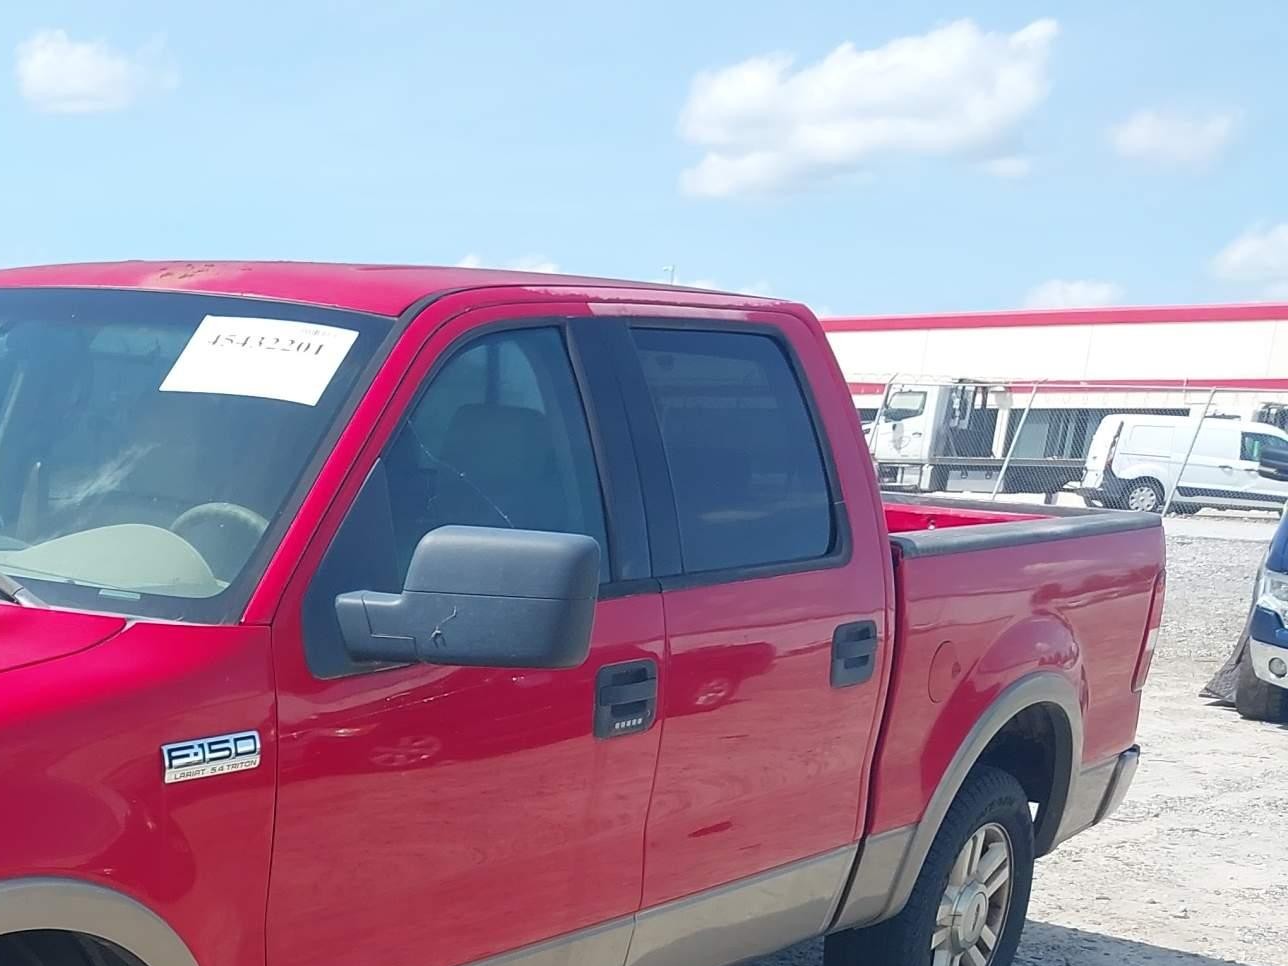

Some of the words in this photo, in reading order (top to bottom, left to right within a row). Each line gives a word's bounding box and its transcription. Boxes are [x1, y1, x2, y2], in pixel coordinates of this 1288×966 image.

[207, 334, 324, 355] 45432201
[167, 734, 258, 769] F-150
[225, 759, 257, 770] TRITON
